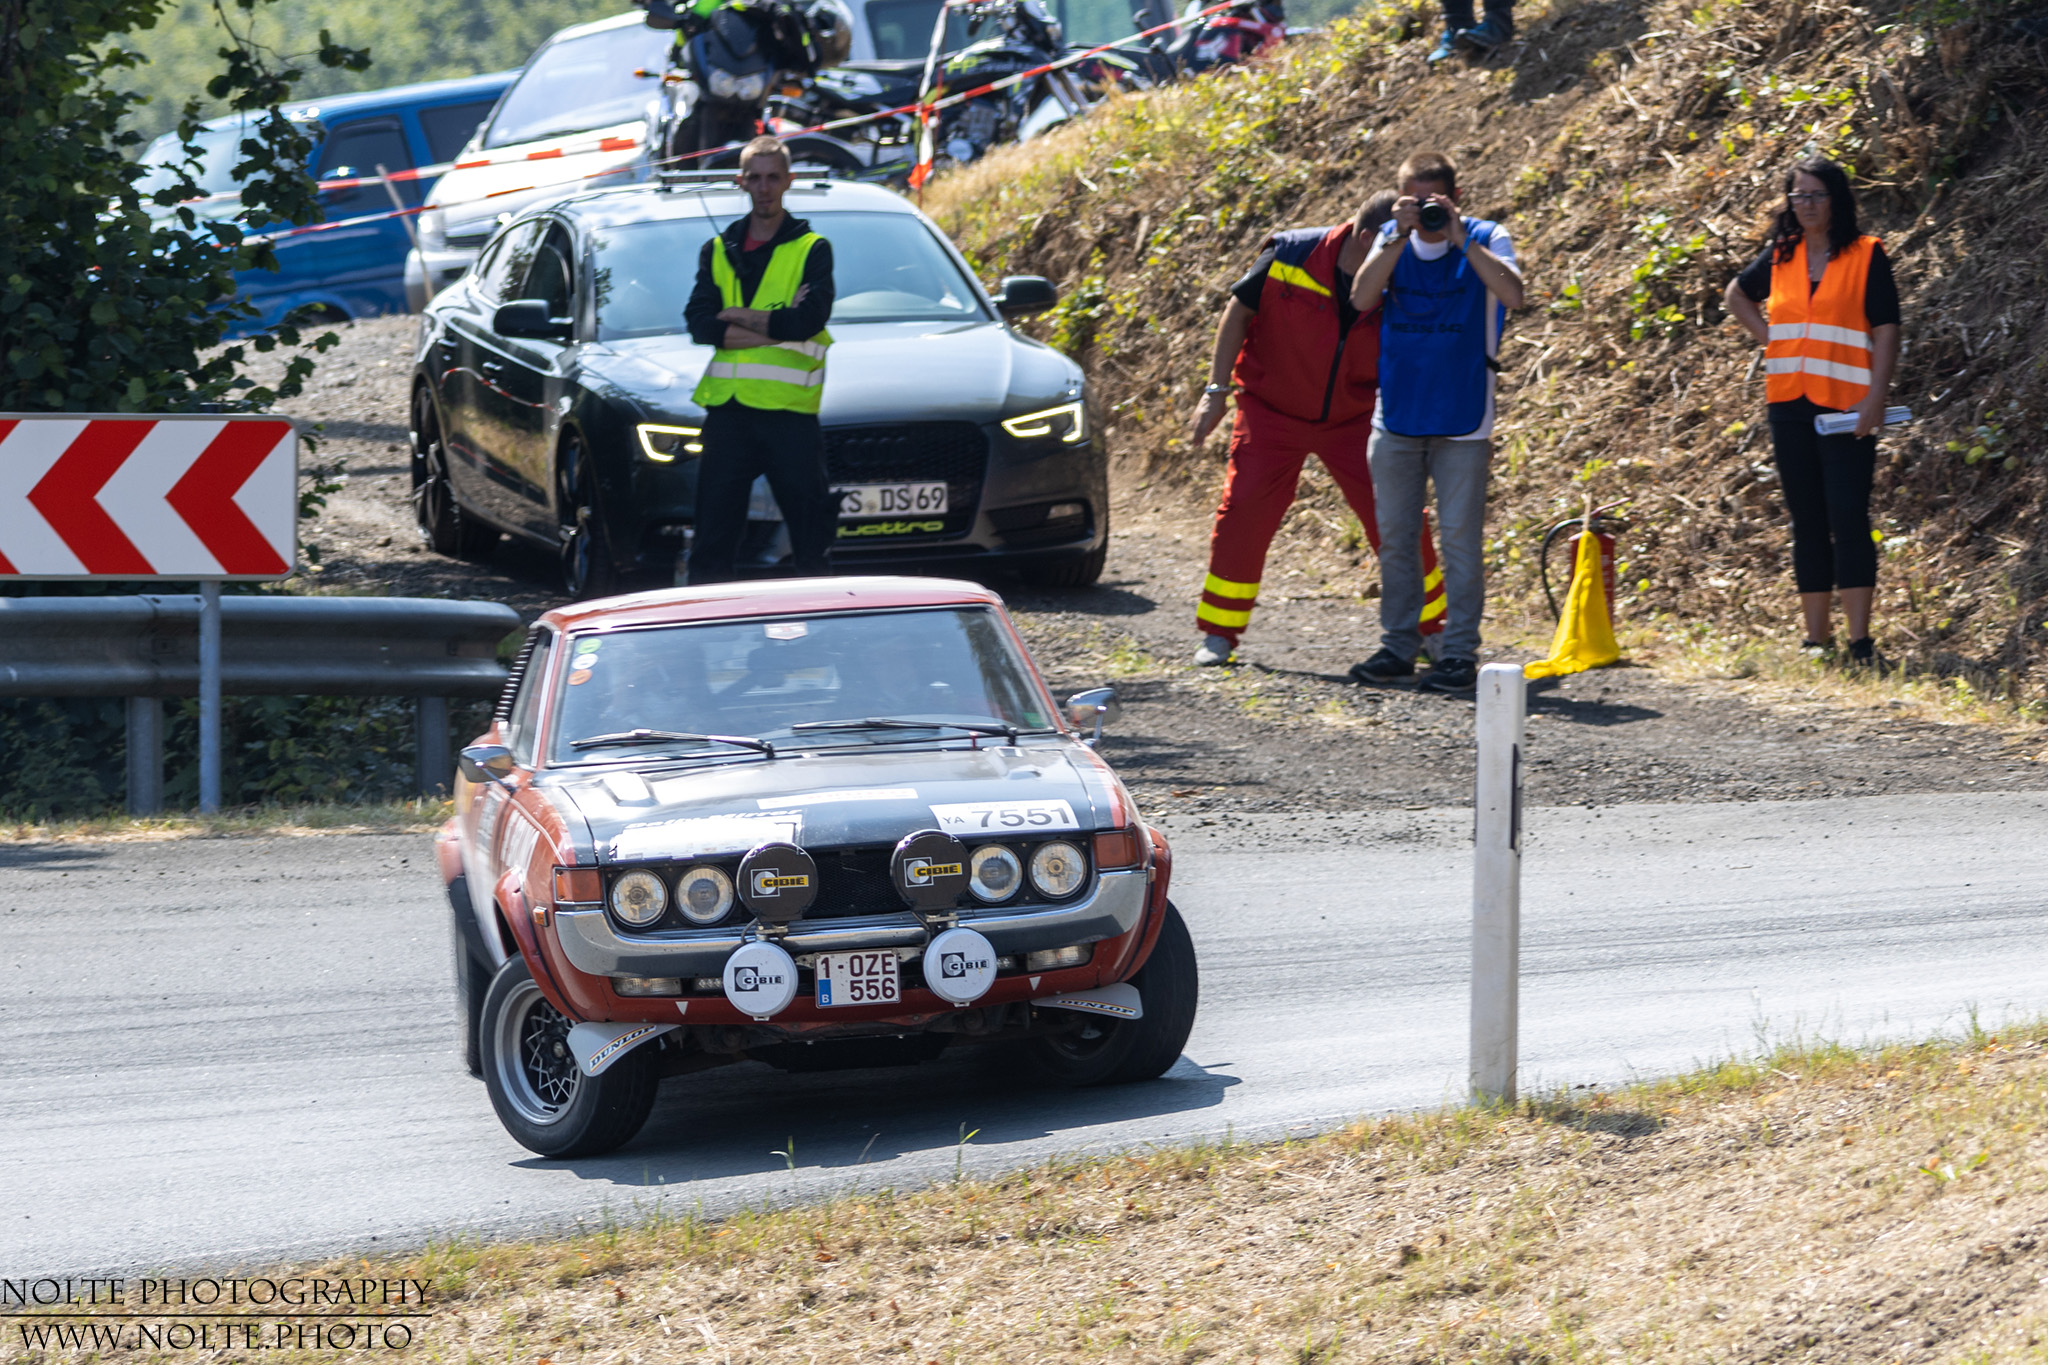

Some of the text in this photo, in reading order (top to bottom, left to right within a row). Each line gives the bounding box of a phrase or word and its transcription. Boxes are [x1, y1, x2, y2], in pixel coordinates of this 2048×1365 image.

[970, 807, 1070, 828] 7551
[821, 993, 830, 1003] B
[850, 977, 896, 1002] 556
[1060, 999, 1134, 1014] DUNLOP
[591, 1024, 656, 1068] DUNLOP
